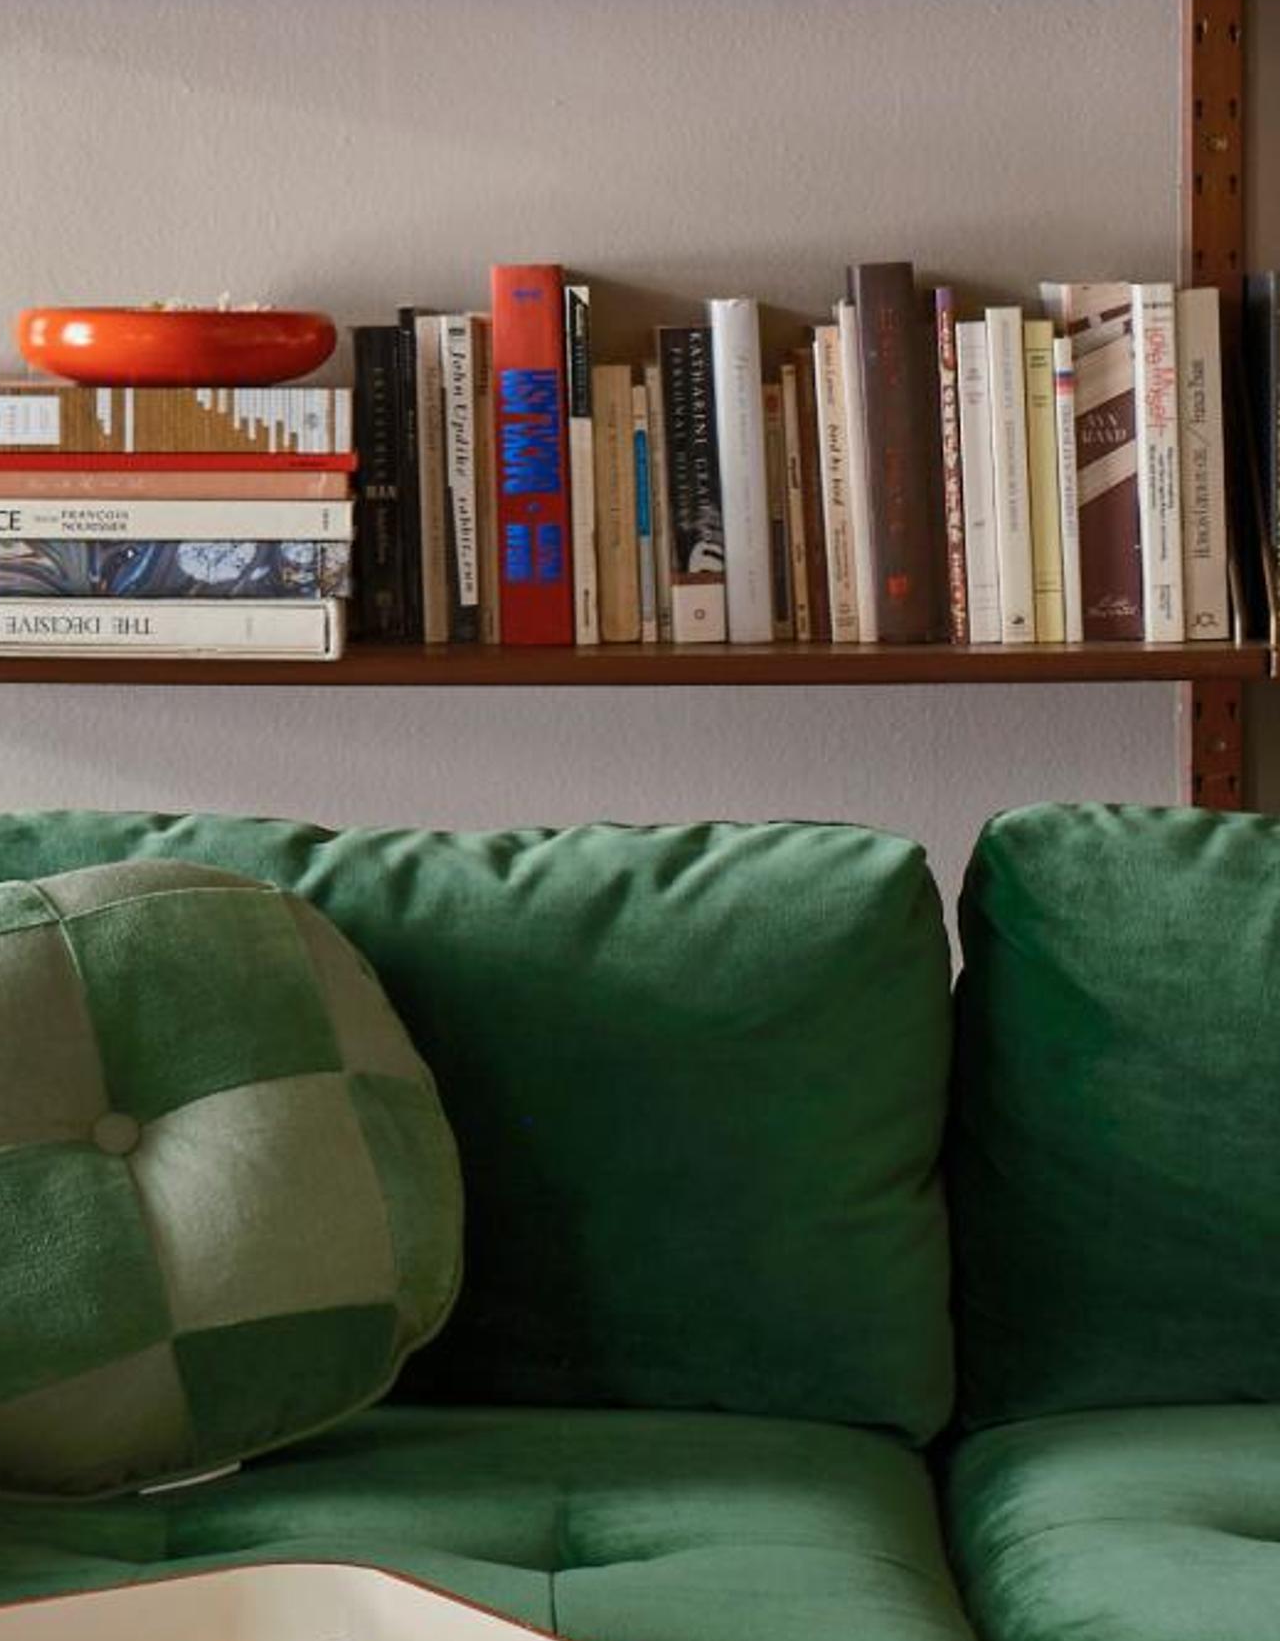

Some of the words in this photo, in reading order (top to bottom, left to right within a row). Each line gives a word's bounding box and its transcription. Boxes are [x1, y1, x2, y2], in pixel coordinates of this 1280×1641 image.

[451, 351, 467, 397] John
[688, 331, 708, 445] KATHARINE
[451, 404, 468, 478] Updike
[1081, 426, 1128, 445] RAND
[5, 615, 101, 634] DECISIVE
[112, 616, 155, 634] THE
